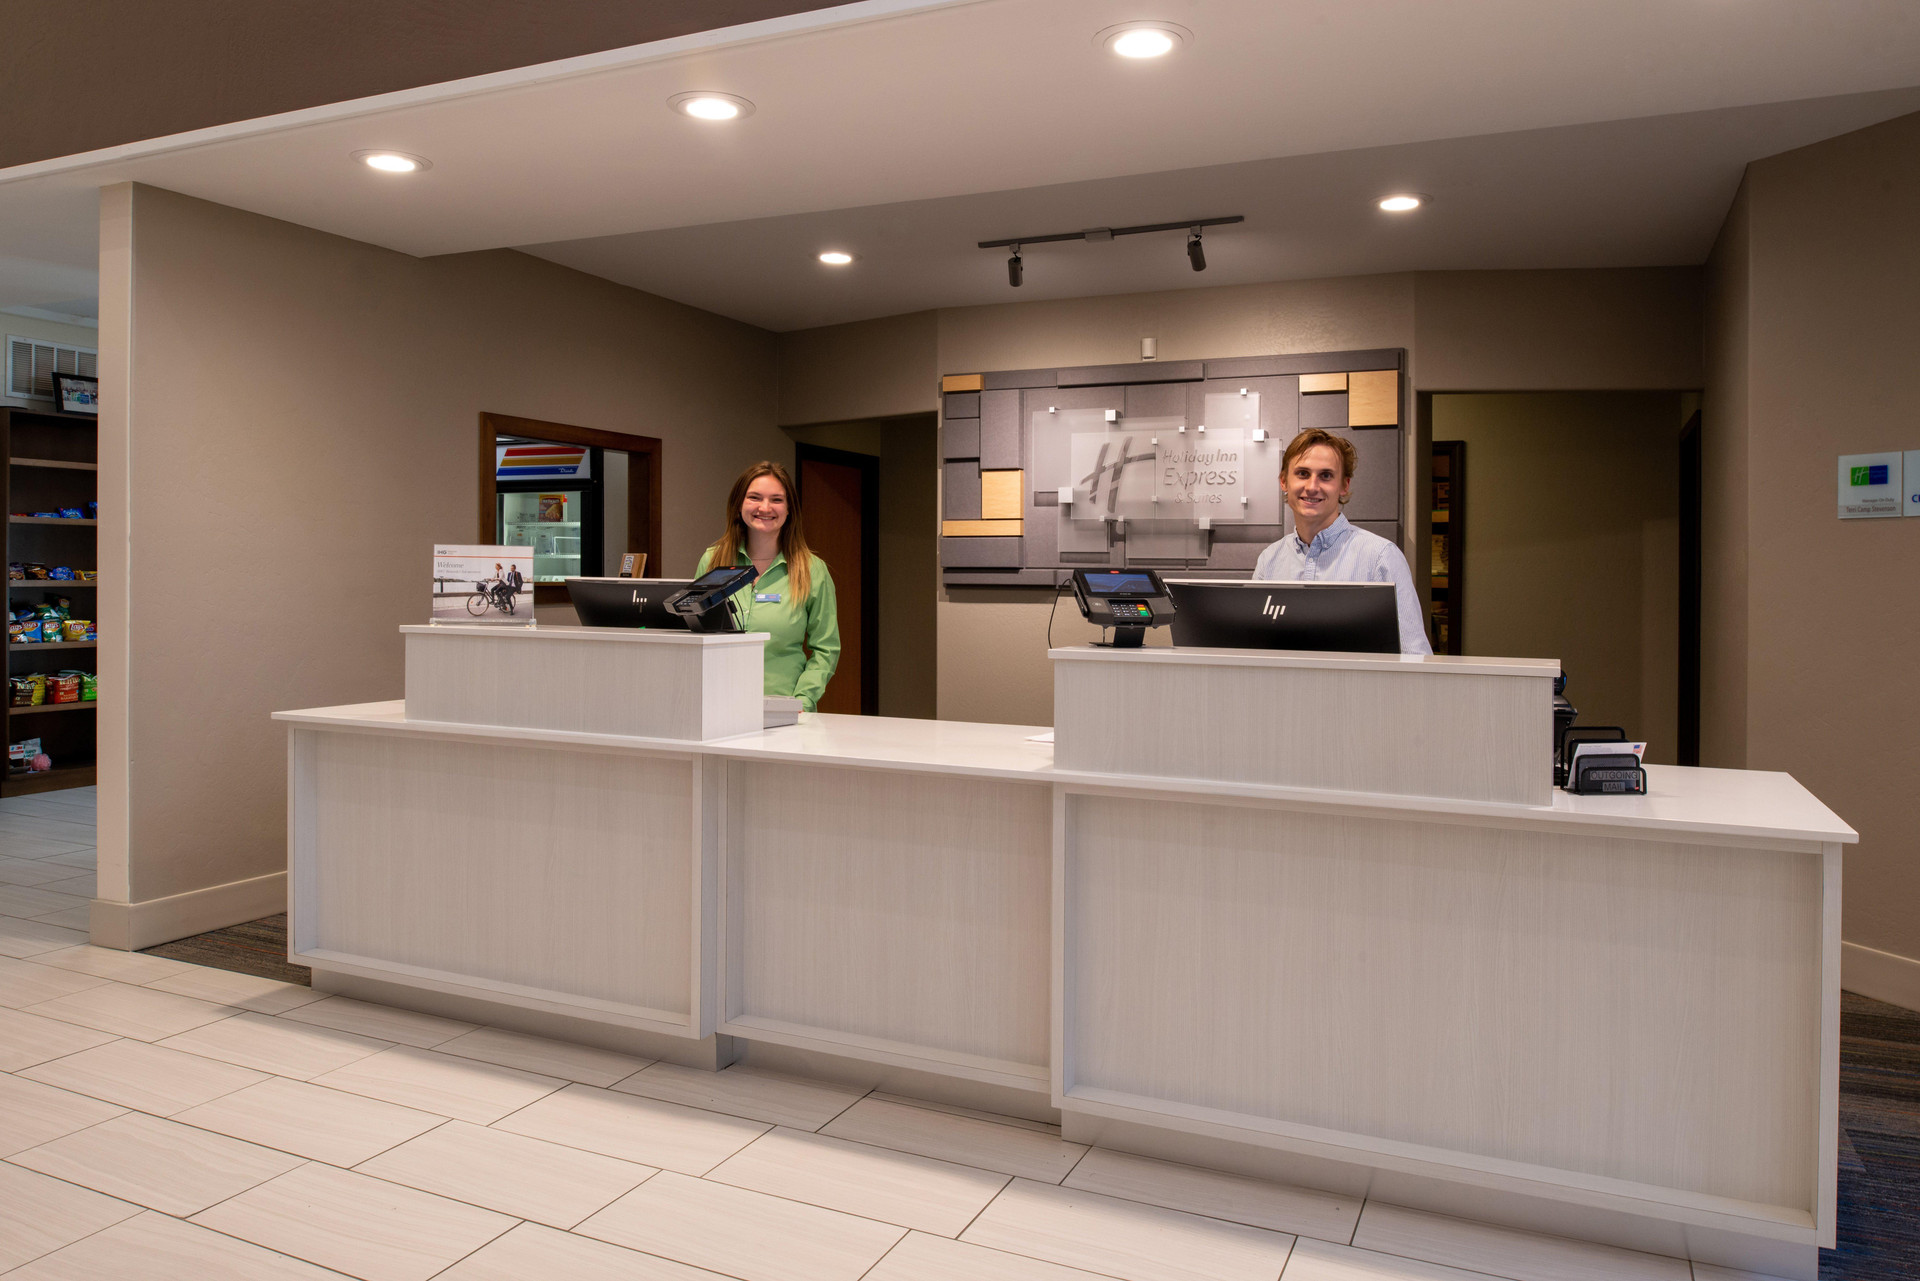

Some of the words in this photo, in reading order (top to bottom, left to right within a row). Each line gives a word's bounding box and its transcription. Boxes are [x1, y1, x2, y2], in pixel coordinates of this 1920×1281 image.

[1162, 450, 1215, 466] Holiday
[1216, 449, 1238, 462] Inn
[1163, 467, 1237, 490] Express
[1175, 492, 1183, 504] &
[1186, 492, 1222, 504] Suites
[437, 561, 465, 569] Welcome
[632, 589, 648, 613] hp
[1262, 595, 1286, 624] hp
[1591, 771, 1638, 780] OUTGOING
[1604, 783, 1623, 791] MAIL
